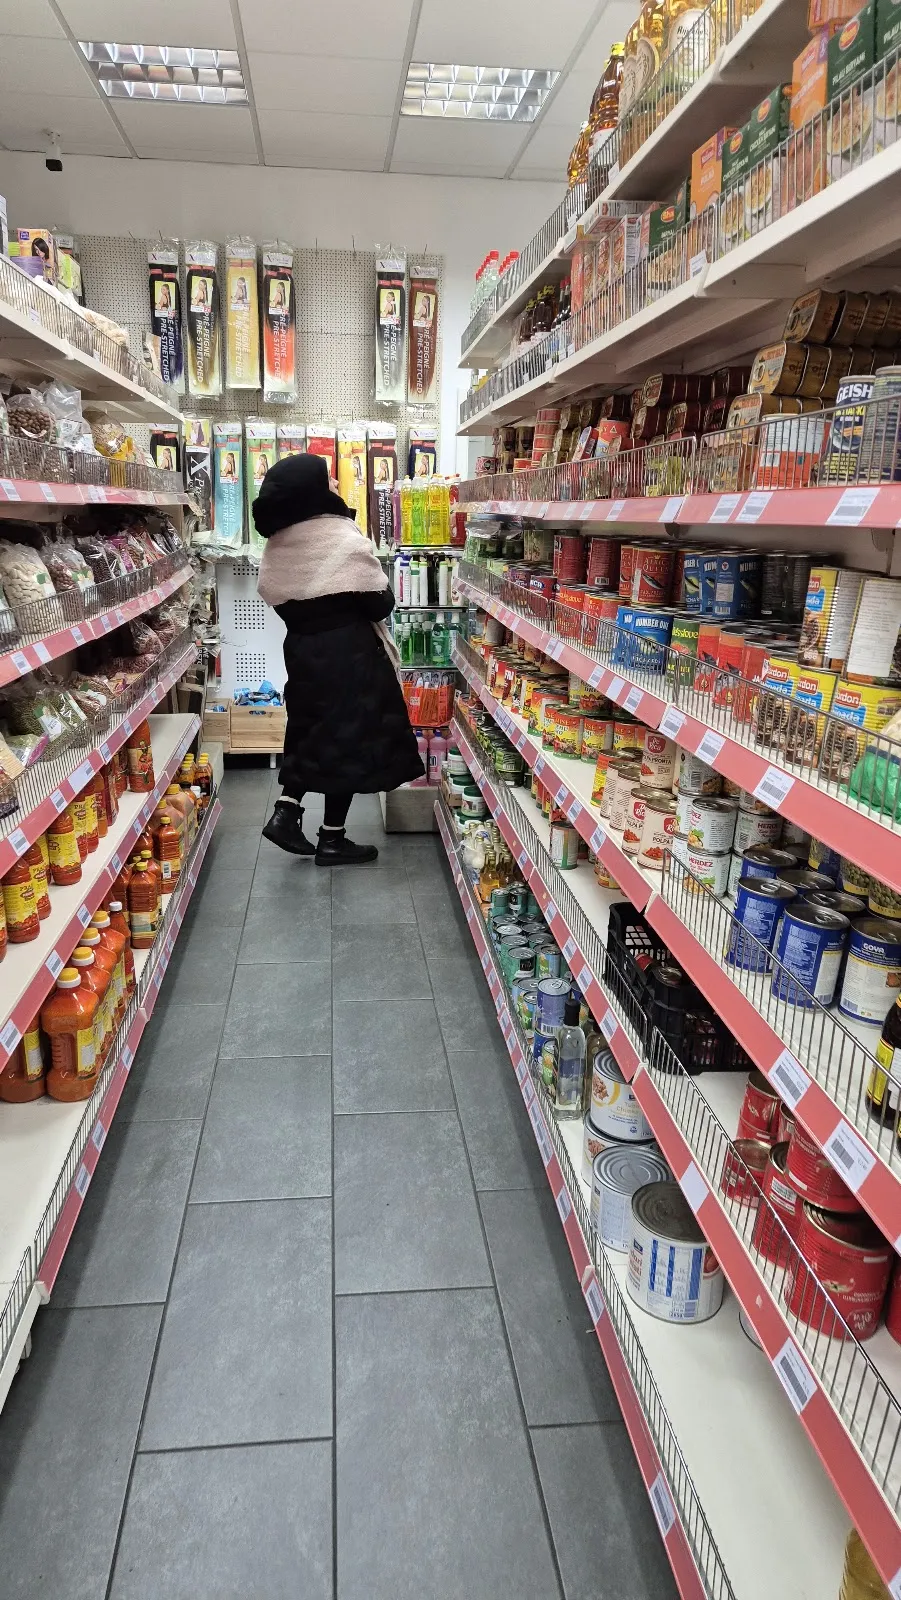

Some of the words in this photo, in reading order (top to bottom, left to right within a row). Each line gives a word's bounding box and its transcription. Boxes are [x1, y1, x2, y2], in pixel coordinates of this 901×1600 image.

[160, 317, 170, 381] PRE-STRETCHED
[195, 319, 204, 383] PRE-STRETCHED
[272, 320, 281, 380] PRE-STRETCHE
[416, 332, 424, 394] PRE-STRETCHED
[836, 383, 874, 405] GEISH
[635, 617, 659, 628] NUMBER
[688, 856, 714, 868] HERDEZ
